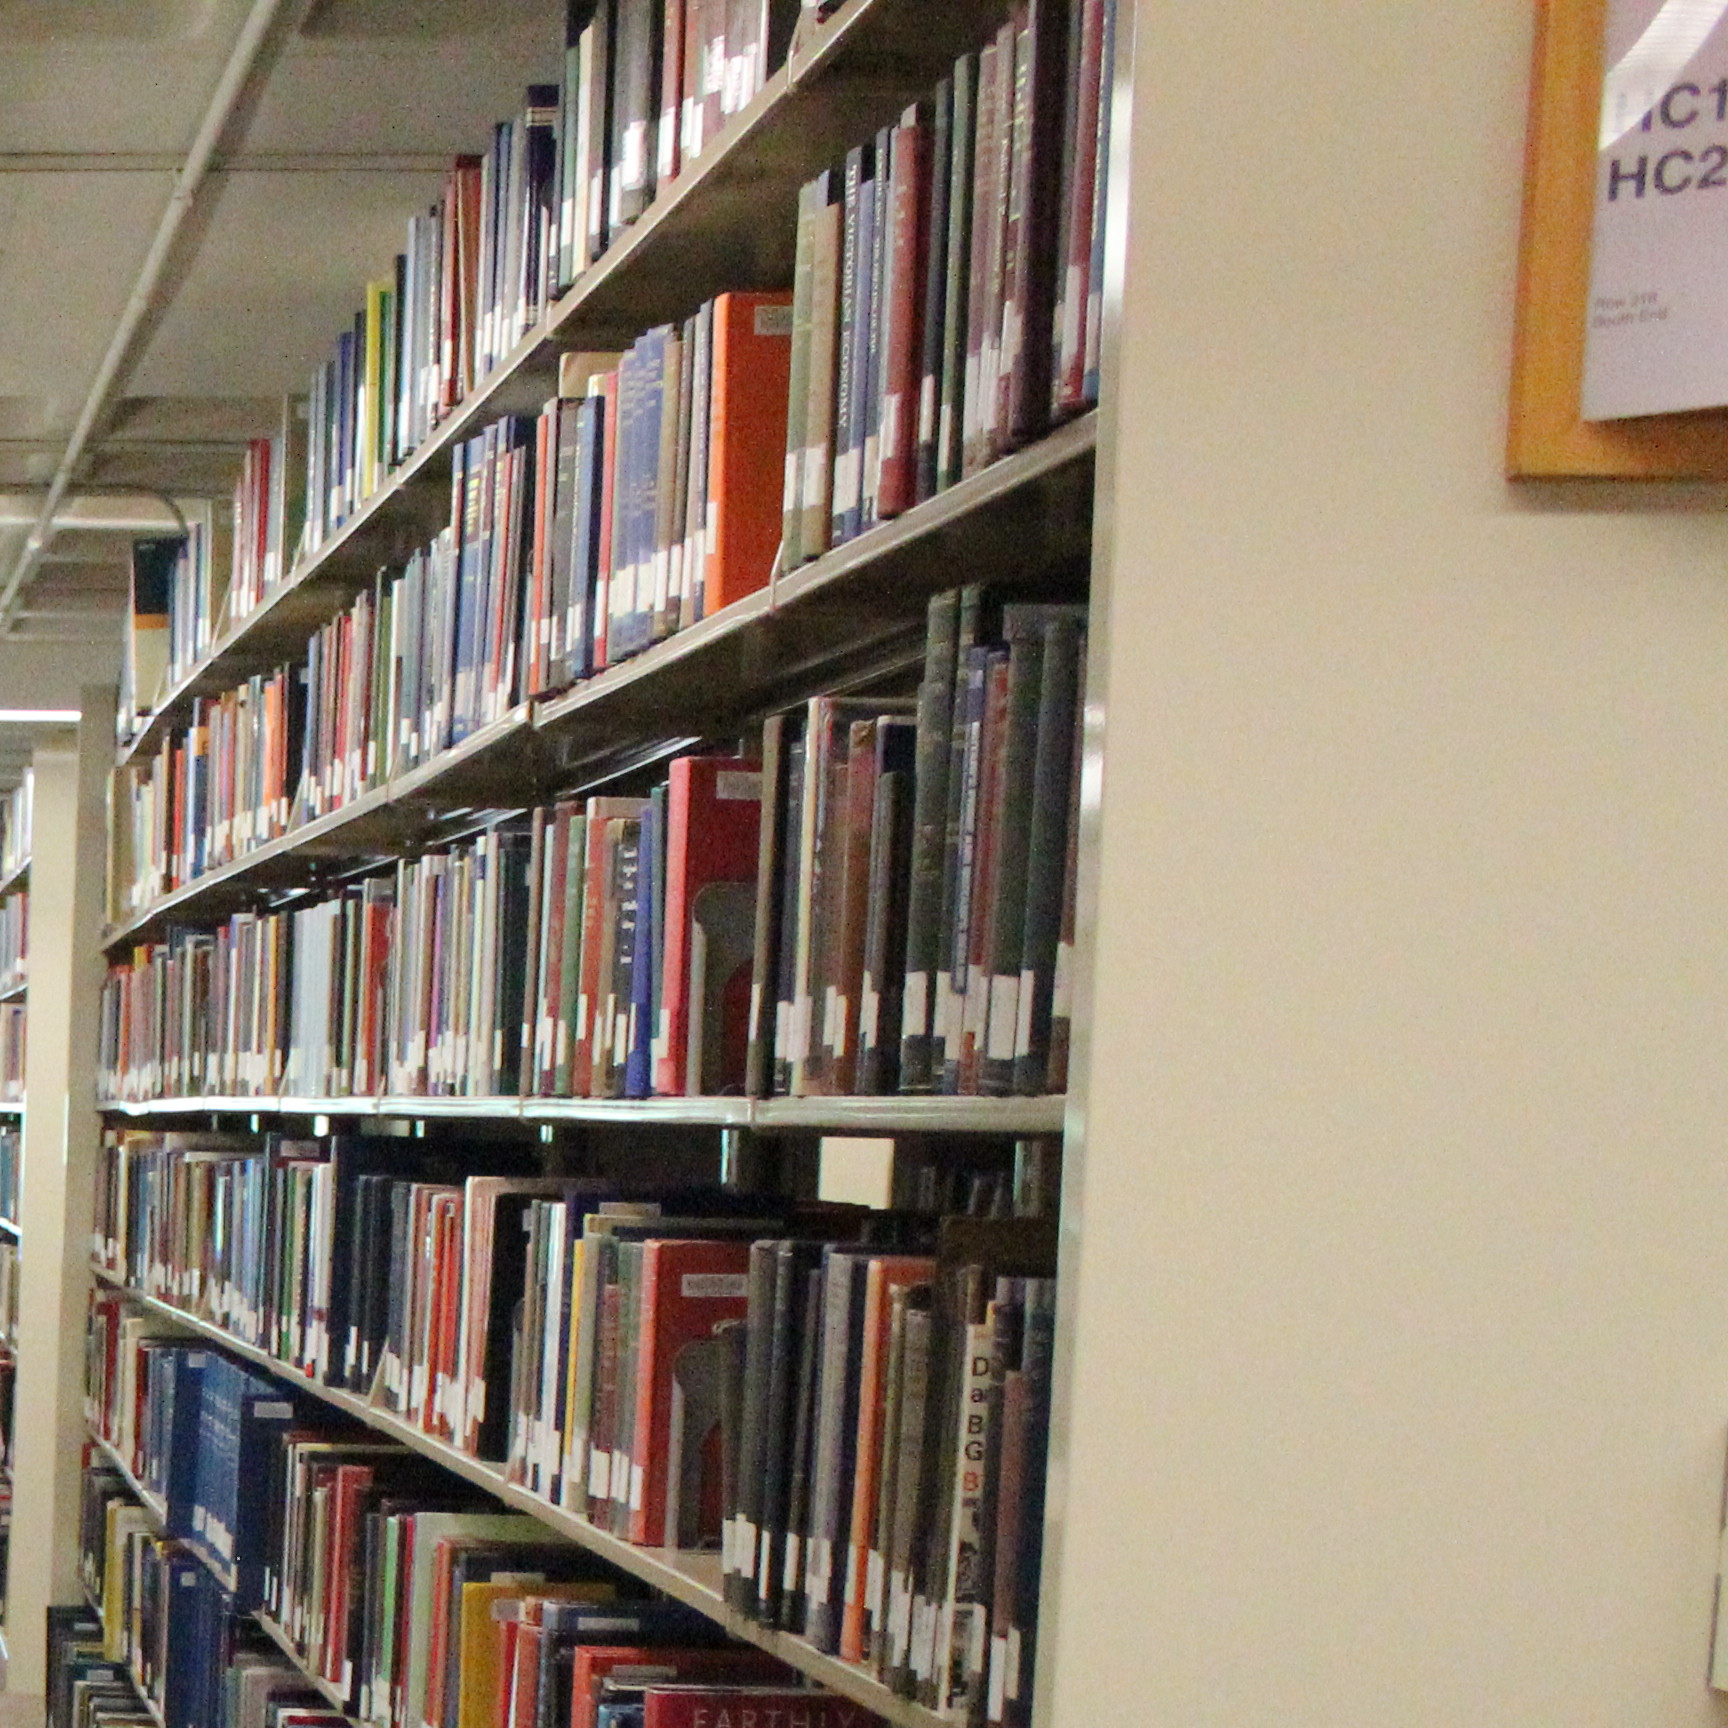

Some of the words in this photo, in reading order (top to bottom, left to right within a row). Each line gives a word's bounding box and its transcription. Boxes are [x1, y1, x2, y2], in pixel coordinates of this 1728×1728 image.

[846, 164, 857, 208] THE
[843, 213, 855, 322] VICTORIAN
[839, 329, 850, 427] ECONOMY
